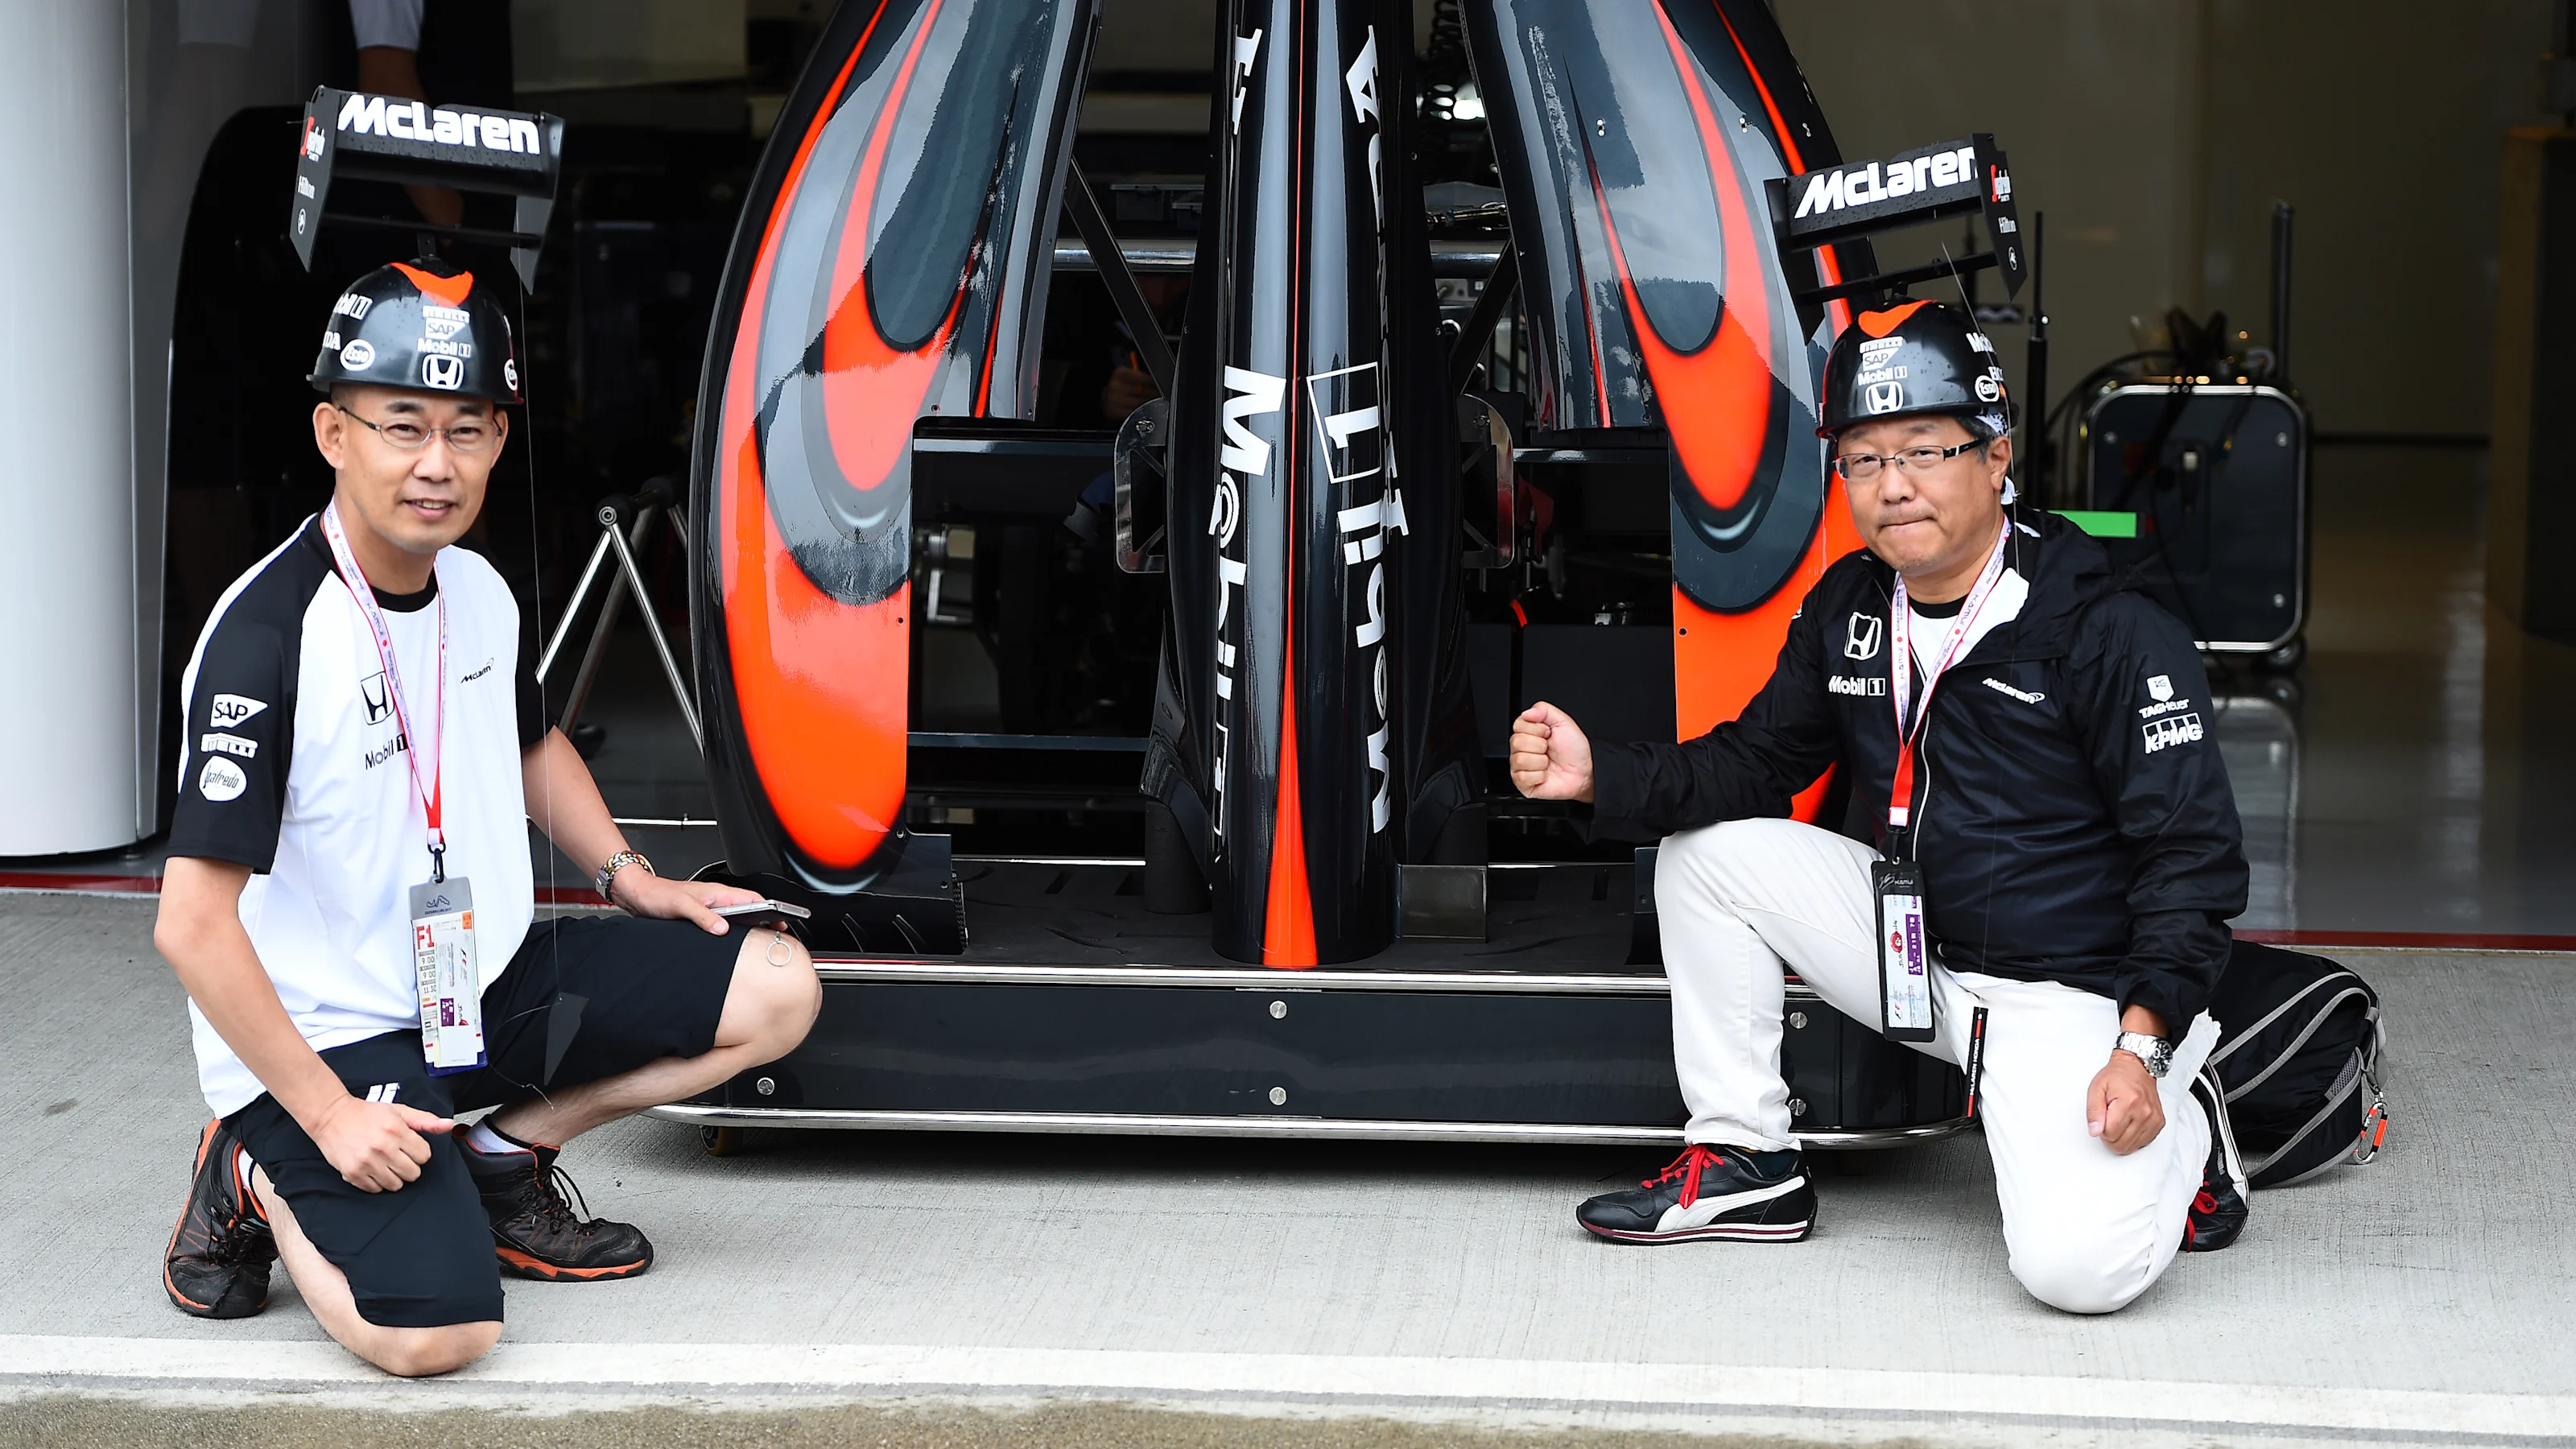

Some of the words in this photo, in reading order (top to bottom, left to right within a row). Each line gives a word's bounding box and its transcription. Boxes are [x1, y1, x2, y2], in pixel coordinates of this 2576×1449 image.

[336, 93, 540, 155] McLaren
[333, 293, 356, 316] obil
[352, 296, 370, 318] 1
[427, 322, 455, 335] SAP
[345, 346, 369, 361] Esso
[417, 337, 457, 356] Mobil
[1864, 352, 1889, 368] SAP
[1857, 369, 1894, 386] Mobil
[1337, 499, 1390, 833] Mobil
[1828, 675, 1867, 697] Mobil
[214, 701, 248, 721] SAP
[2145, 723, 2204, 754] KPMG
[365, 739, 394, 770] Mobil
[416, 924, 435, 950] F1
